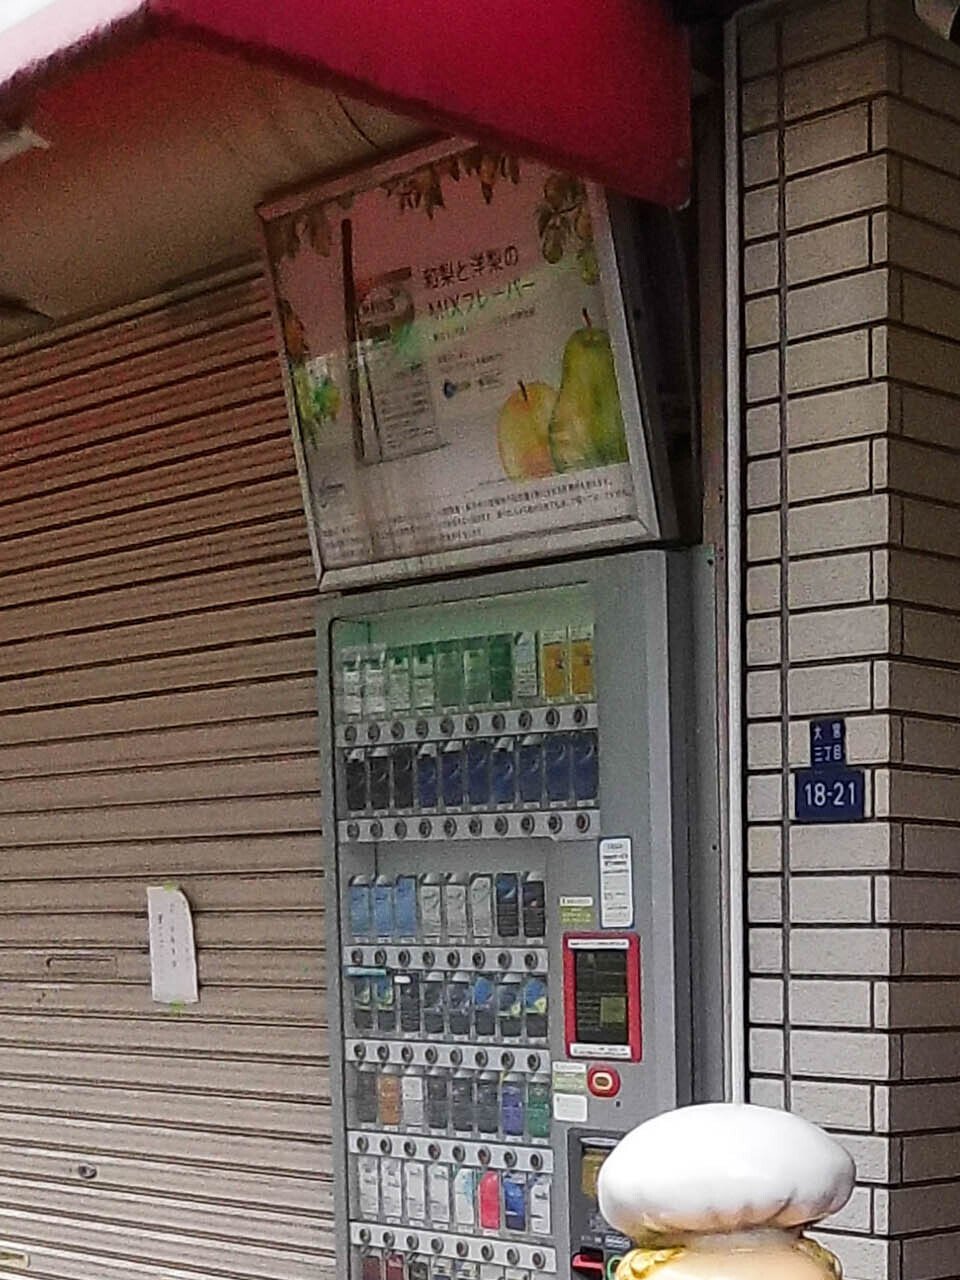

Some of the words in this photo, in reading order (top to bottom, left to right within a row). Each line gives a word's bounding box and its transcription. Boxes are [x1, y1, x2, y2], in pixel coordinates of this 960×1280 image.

[813, 744, 842, 762] 三丁目
[804, 781, 855, 806] 18-21
